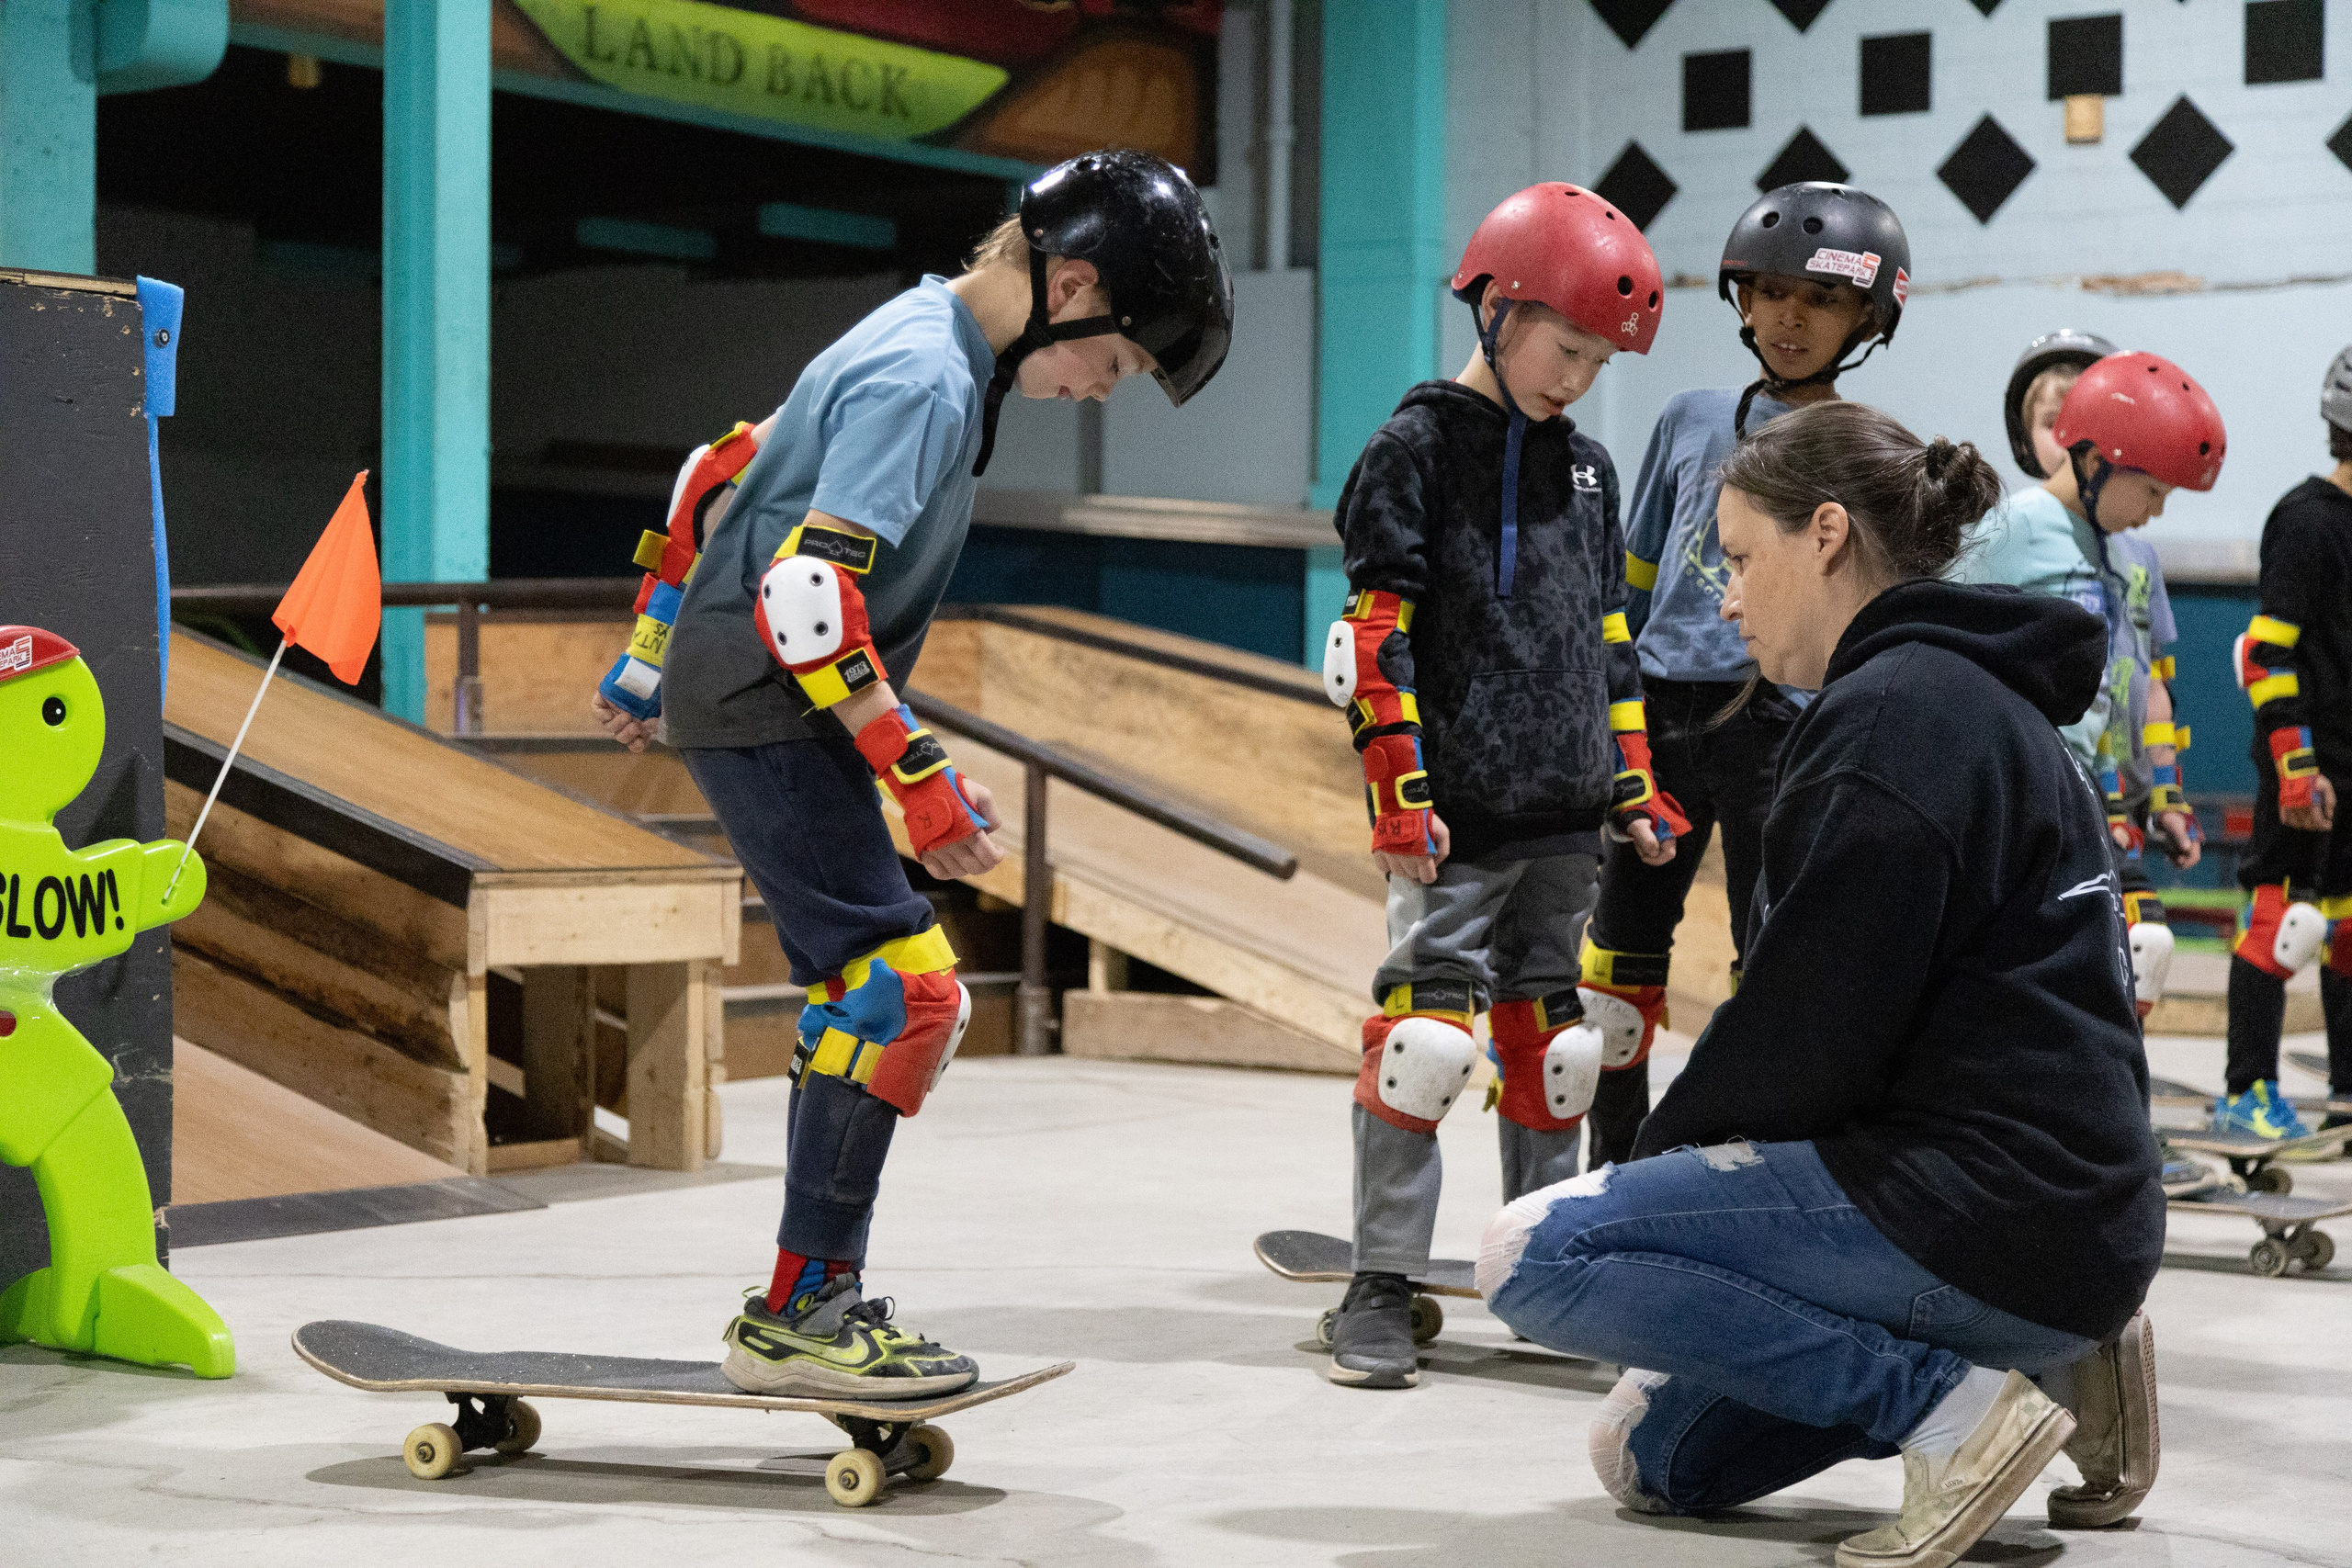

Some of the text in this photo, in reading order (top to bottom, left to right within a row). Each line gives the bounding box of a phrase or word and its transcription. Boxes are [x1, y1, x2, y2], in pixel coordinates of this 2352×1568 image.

[582, 4, 912, 118] LAND BACK
[1816, 250, 1862, 265] CINEMA
[1808, 260, 1867, 276] SKATEPARK
[804, 539, 866, 558] PRO TEC
[0, 647, 16, 660] MA
